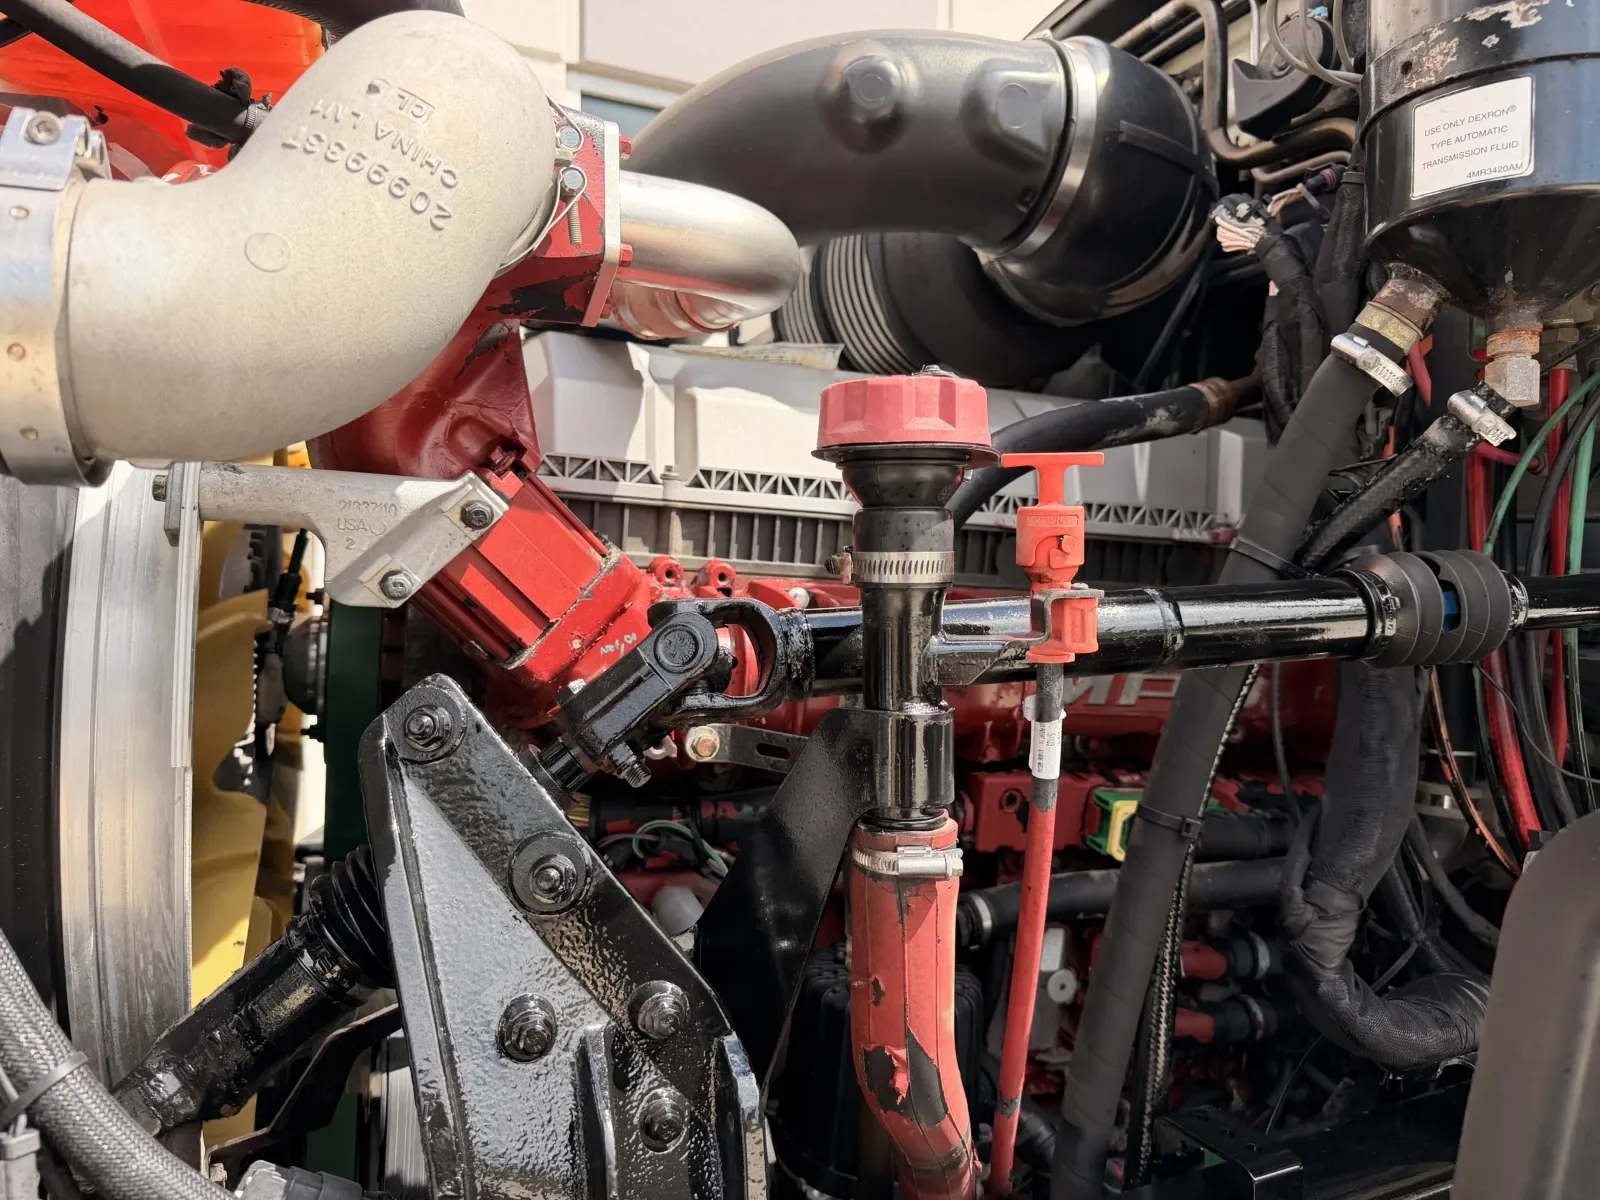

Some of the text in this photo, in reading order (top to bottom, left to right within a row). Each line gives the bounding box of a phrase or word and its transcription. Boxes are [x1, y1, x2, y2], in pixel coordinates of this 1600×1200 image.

[1424, 126, 1441, 137] USE
[1442, 118, 1466, 131] ONLY
[1430, 125, 1509, 151] TYPE AUTOMATIC
[374, 120, 458, 189] CHINA
[1422, 140, 1519, 170] TRANSMISSION FLUID
[1466, 162, 1524, 179] 4MR3420AM
[337, 517, 368, 532] USA
